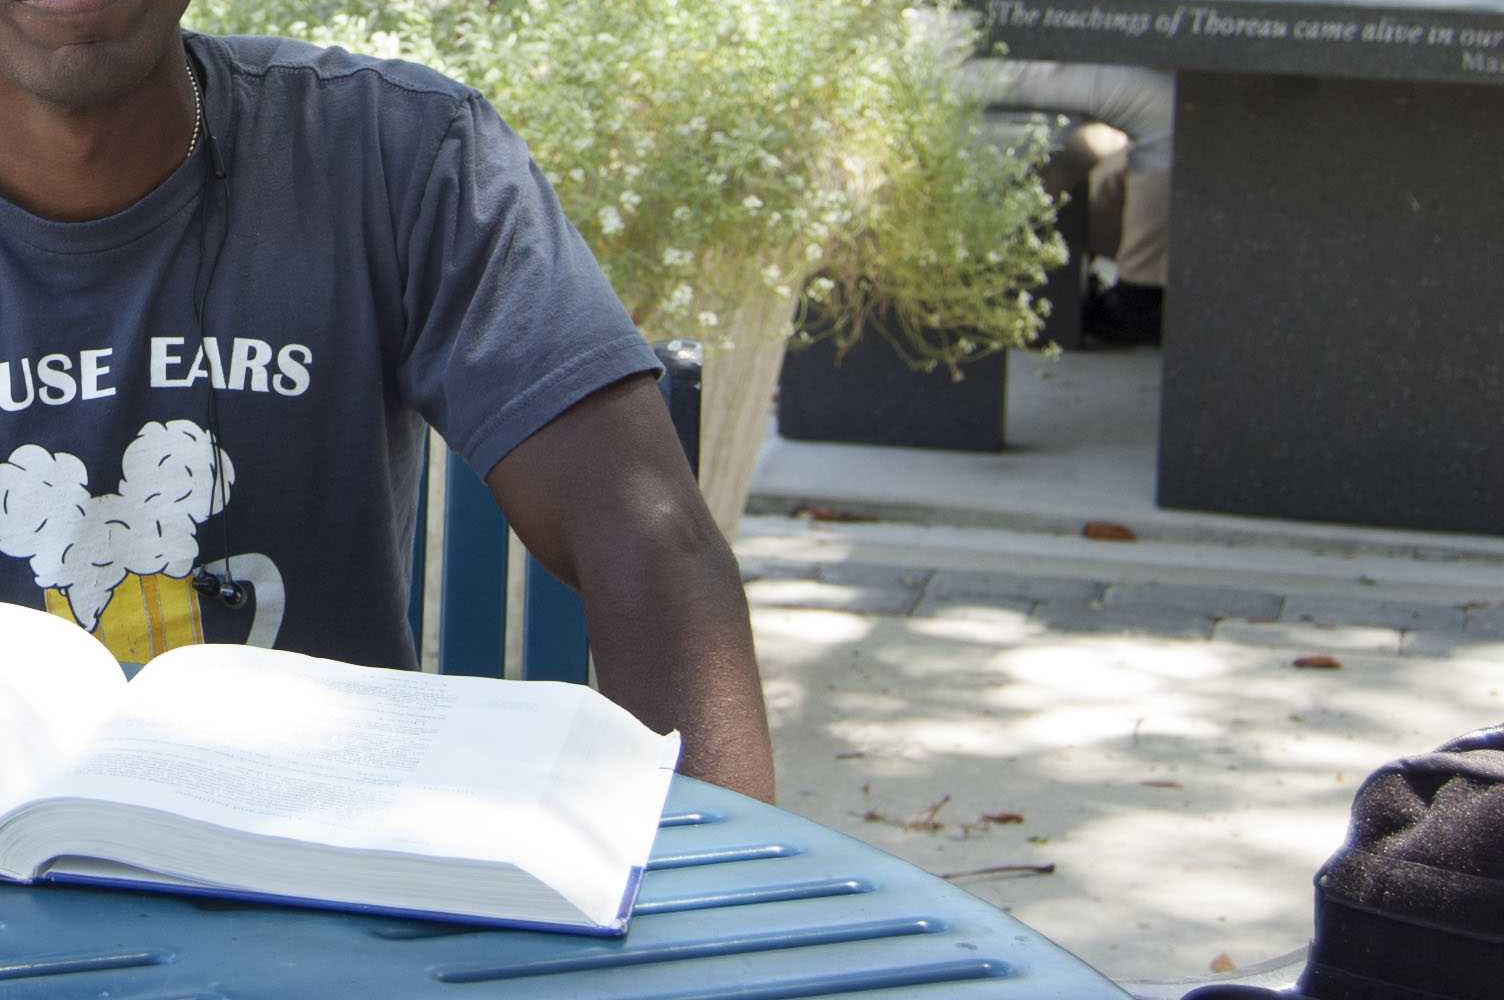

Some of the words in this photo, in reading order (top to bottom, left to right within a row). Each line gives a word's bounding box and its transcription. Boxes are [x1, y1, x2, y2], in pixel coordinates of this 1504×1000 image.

[1045, 7, 1152, 38] teachings
[1155, 6, 1187, 39] of
[1189, 7, 1288, 37] Thoreau
[1294, 19, 1358, 42] came
[1361, 16, 1423, 45] alive
[1427, 24, 1453, 46] in
[150, 336, 314, 397] EARS
